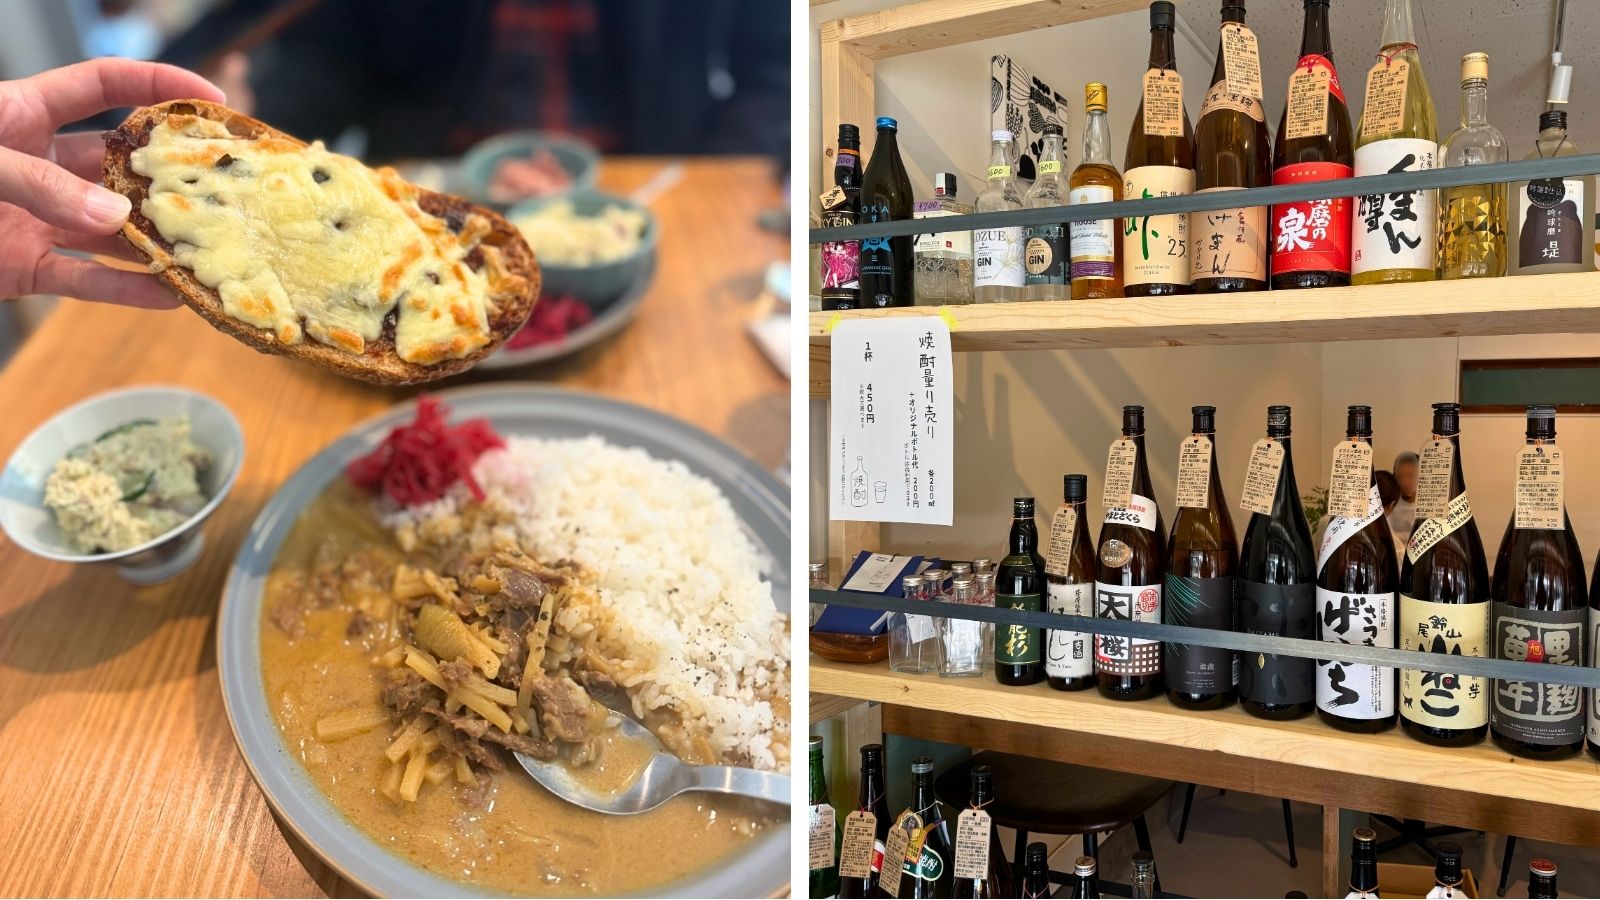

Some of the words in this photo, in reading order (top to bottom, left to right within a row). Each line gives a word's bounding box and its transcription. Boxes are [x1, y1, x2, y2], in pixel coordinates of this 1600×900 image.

[1277, 208, 1315, 252] 泉
[1306, 198, 1332, 240] 磨の
[977, 257, 992, 267] GIN
[1028, 255, 1045, 265] GIN
[1167, 239, 1186, 258] 25
[1542, 241, 1560, 258] 堤
[864, 341, 873, 363] 1杯
[918, 331, 938, 439] 焼酎量り売り
[866, 383, 875, 424] 450円
[1099, 596, 1127, 658] 大桜
